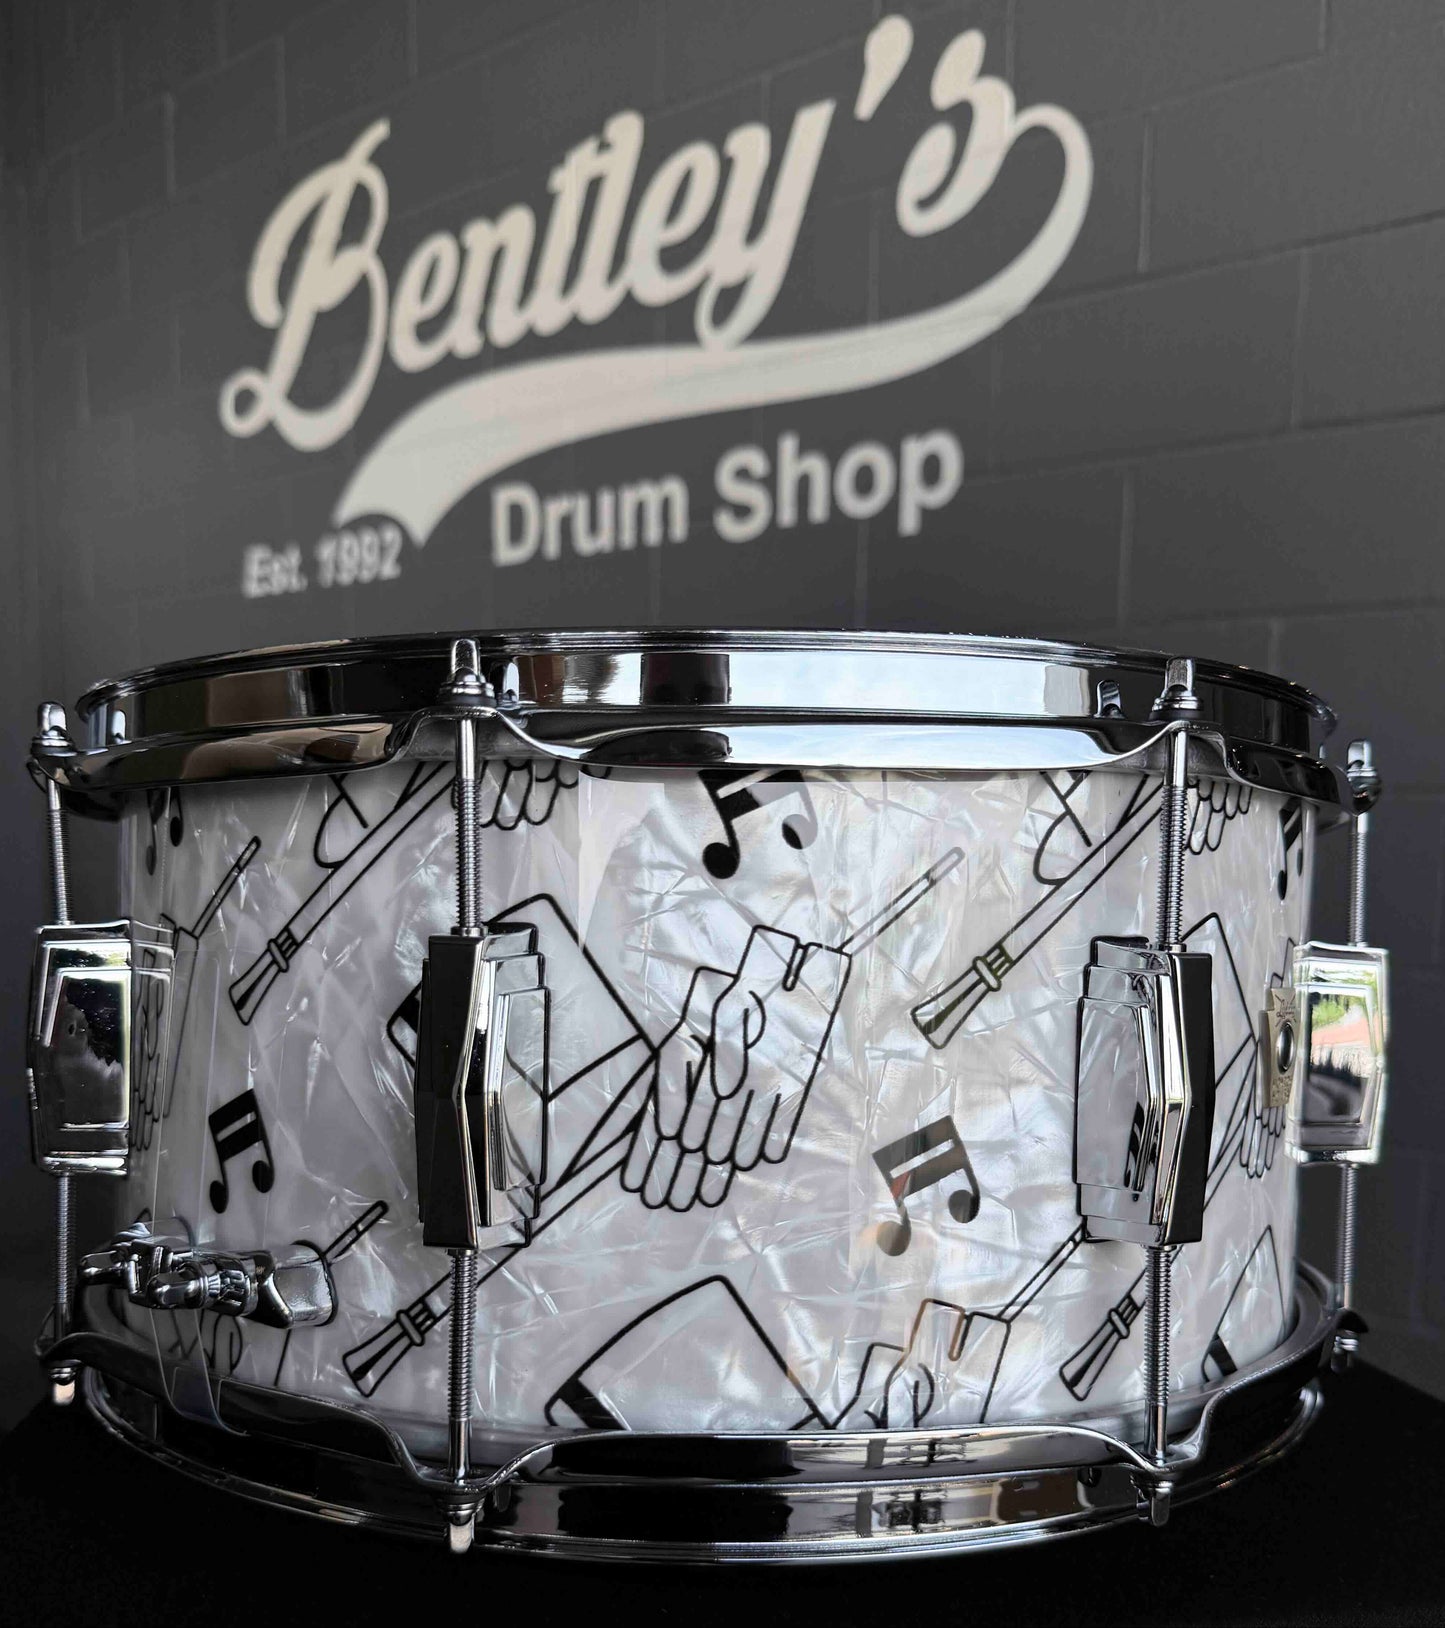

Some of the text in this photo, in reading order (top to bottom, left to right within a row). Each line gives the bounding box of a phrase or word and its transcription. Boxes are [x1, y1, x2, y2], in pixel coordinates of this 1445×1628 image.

[220, 14, 1092, 451] Bentley's
[243, 525, 402, 598] Est. 1992
[492, 430, 963, 567] Drum Shop
